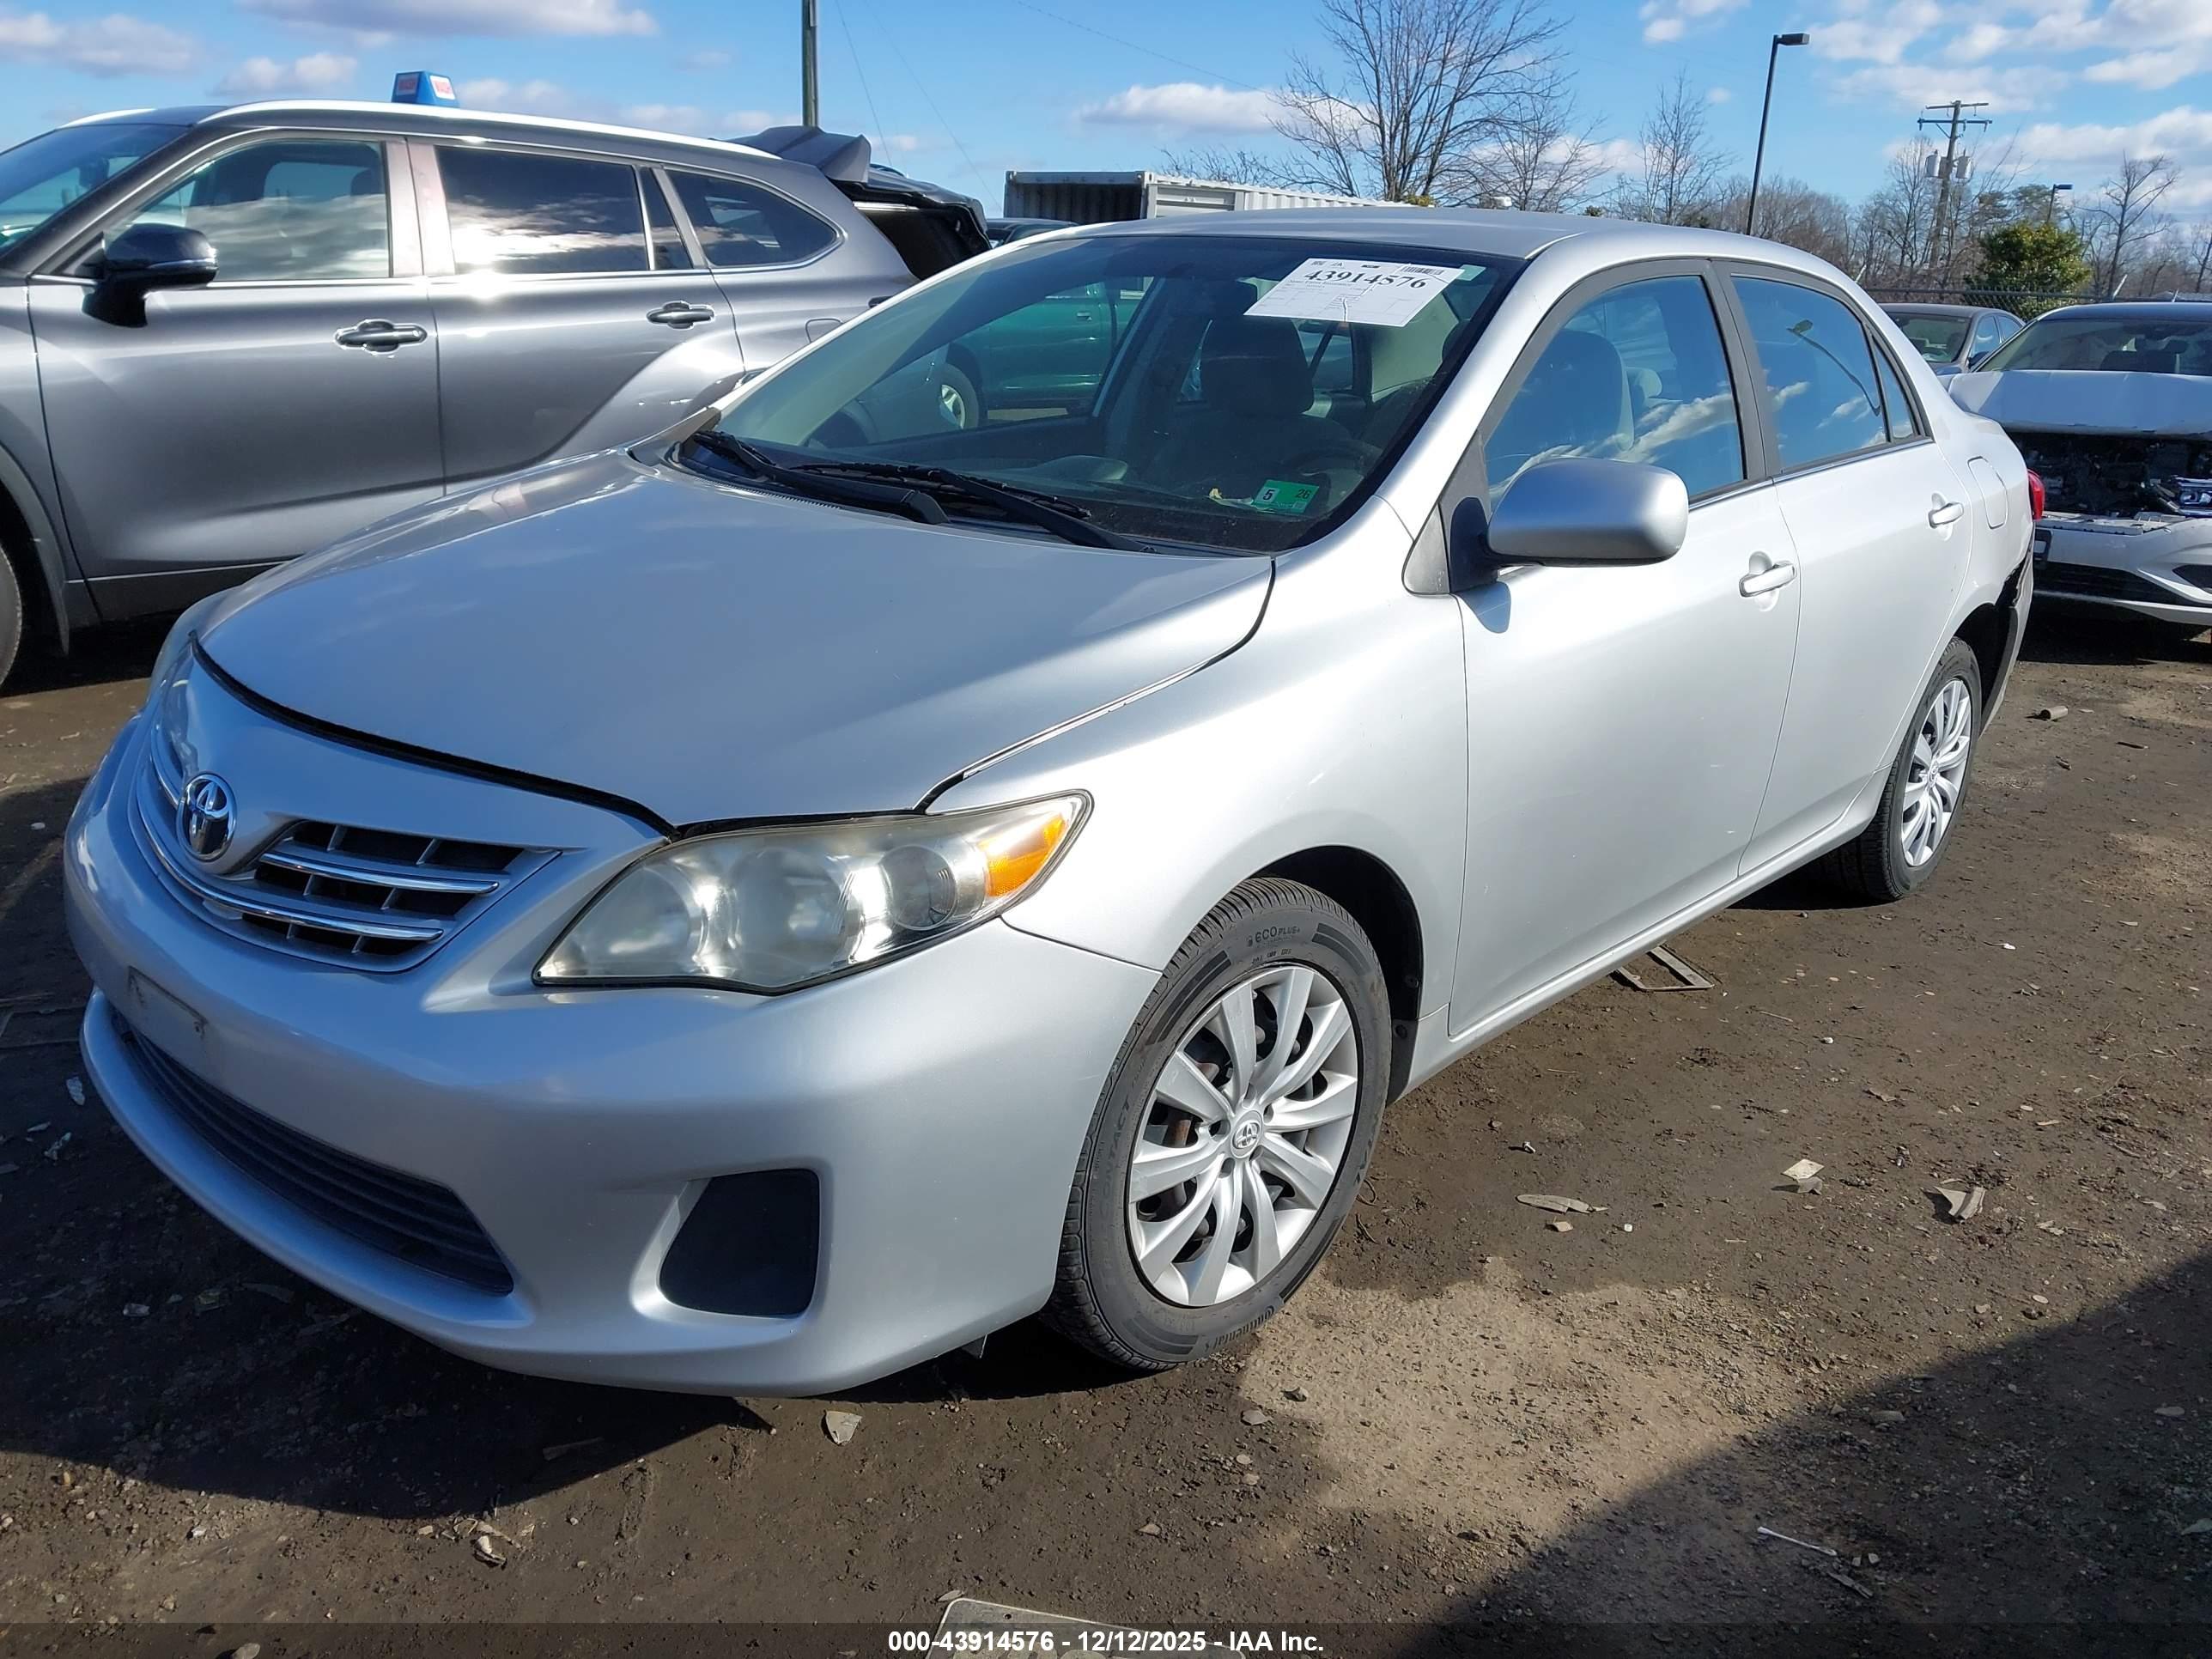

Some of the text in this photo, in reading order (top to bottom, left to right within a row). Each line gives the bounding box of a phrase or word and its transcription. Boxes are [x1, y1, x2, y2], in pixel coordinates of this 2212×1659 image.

[1304, 269, 1427, 289] 43914576
[1262, 489, 1276, 501] 5
[1295, 488, 1312, 500] 26
